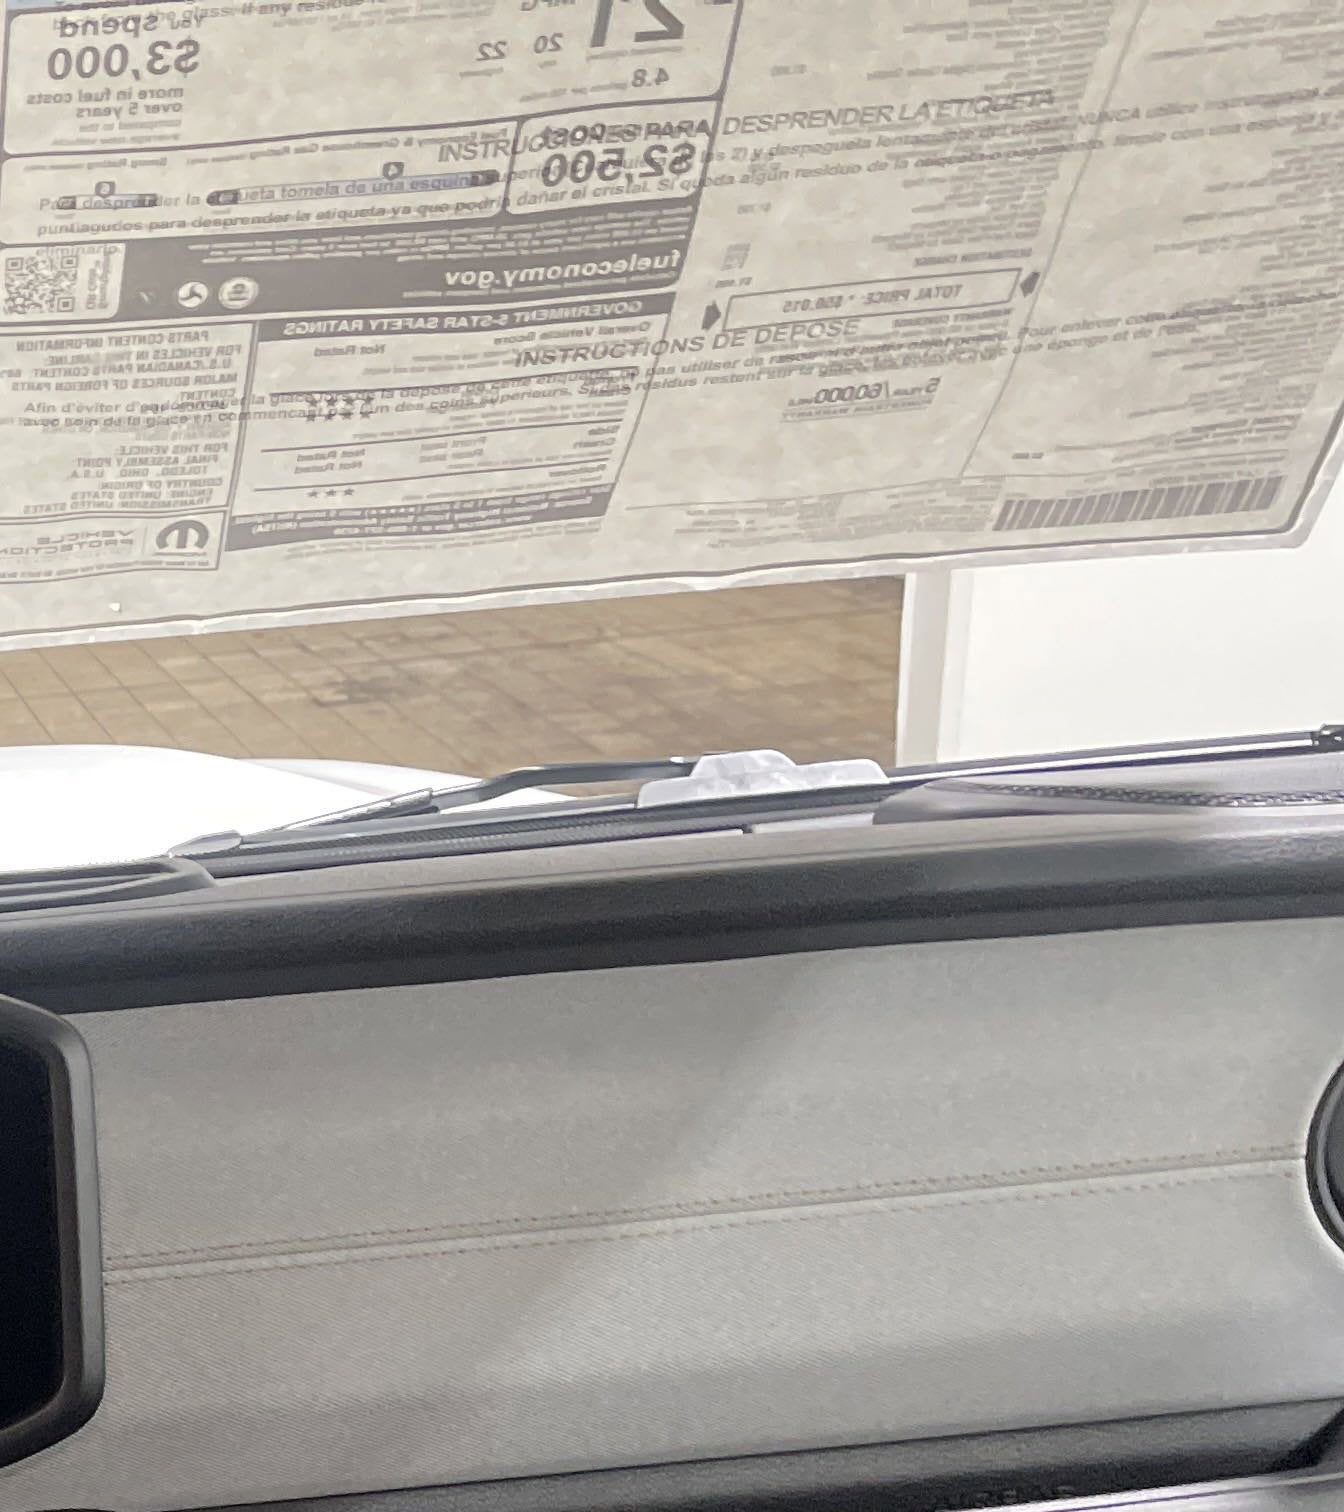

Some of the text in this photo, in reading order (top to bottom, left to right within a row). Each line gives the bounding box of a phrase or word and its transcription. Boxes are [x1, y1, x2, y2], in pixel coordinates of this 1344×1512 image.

[723, 104, 895, 135] DESPRENDER
[899, 102, 930, 121] LA
[186, 193, 200, 206] la
[281, 182, 340, 200] tomela
[345, 182, 366, 195] de
[517, 188, 566, 207] dañar
[514, 319, 861, 368] INSTRUCTIONS DE DEPOSE
[24, 401, 58, 415] Afin
[680, 357, 741, 375] utiliser
